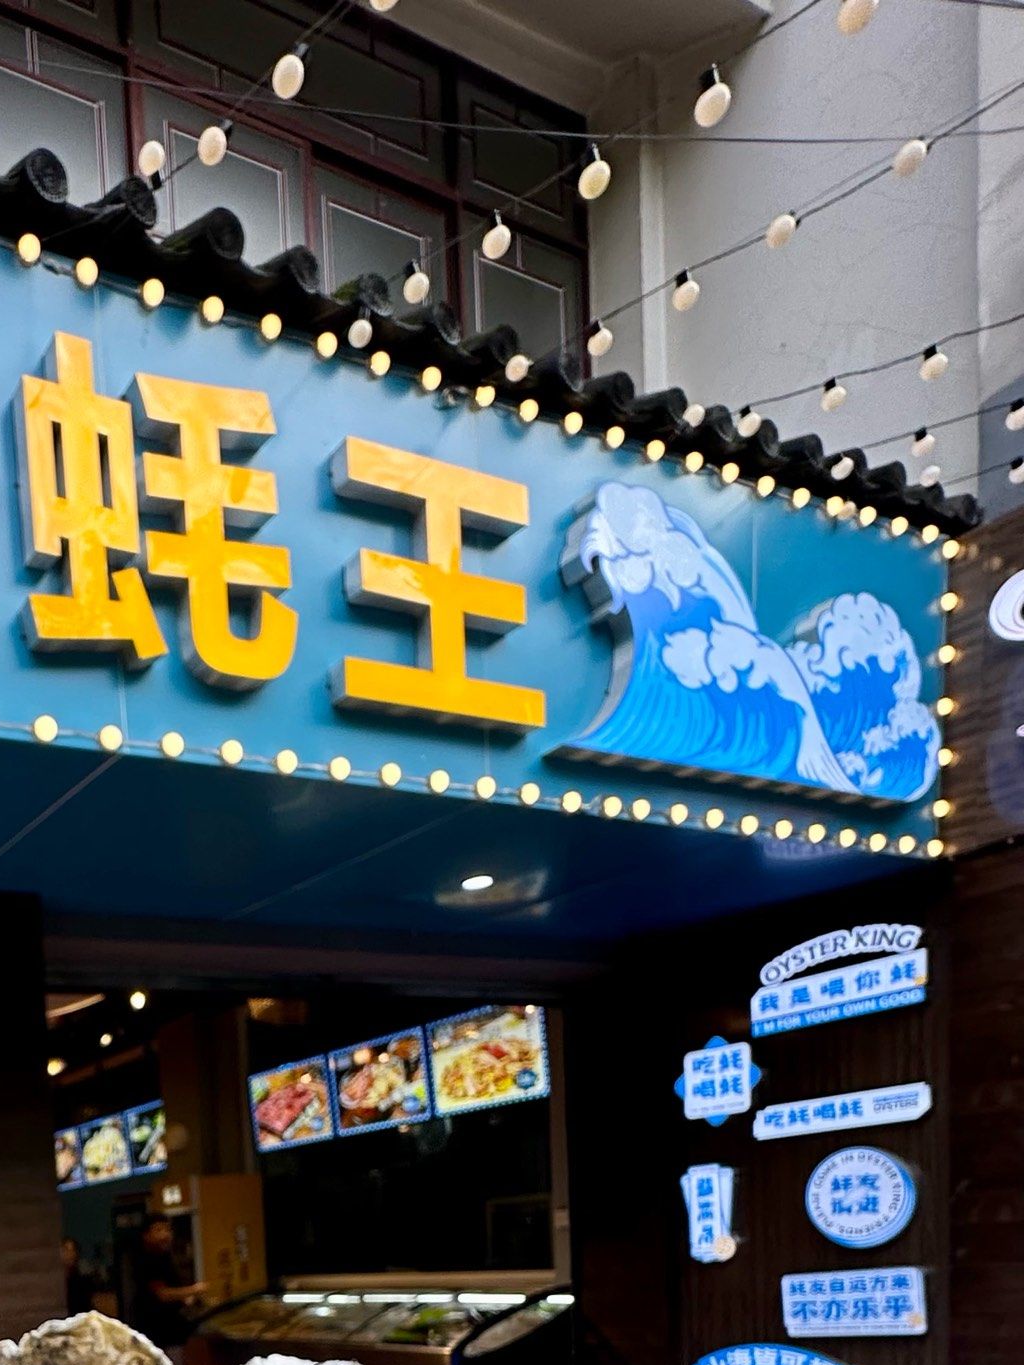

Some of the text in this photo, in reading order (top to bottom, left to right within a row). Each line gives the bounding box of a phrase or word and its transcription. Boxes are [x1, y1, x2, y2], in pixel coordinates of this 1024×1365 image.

[765, 928, 916, 982] OYSTER KING
[843, 1000, 877, 1017] OWN
[879, 989, 922, 1009] GOOD
[791, 1294, 914, 1321] 不亦乐乎
